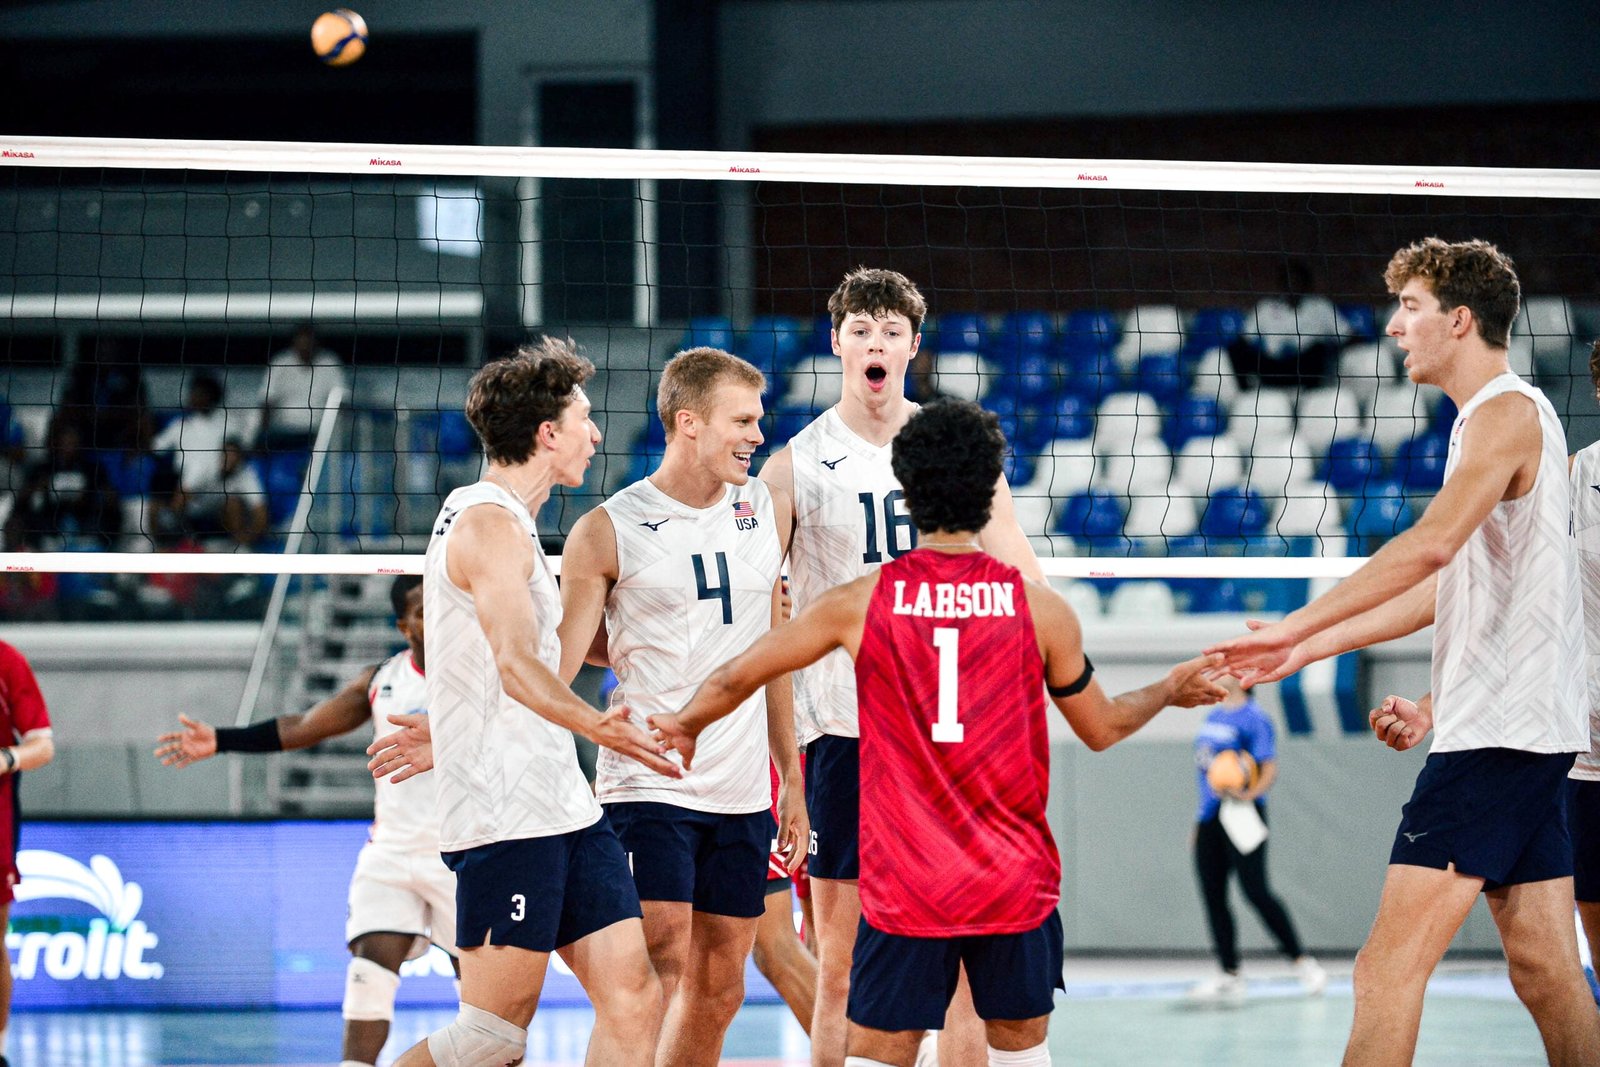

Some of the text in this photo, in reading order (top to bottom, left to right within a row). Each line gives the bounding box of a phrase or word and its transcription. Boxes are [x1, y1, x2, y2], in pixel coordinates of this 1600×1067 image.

[735, 517, 760, 531] USA
[858, 490, 919, 564] 16
[690, 551, 734, 625] 4
[893, 580, 1016, 619] LARSON
[931, 626, 965, 744] 1
[510, 893, 527, 922] 3
